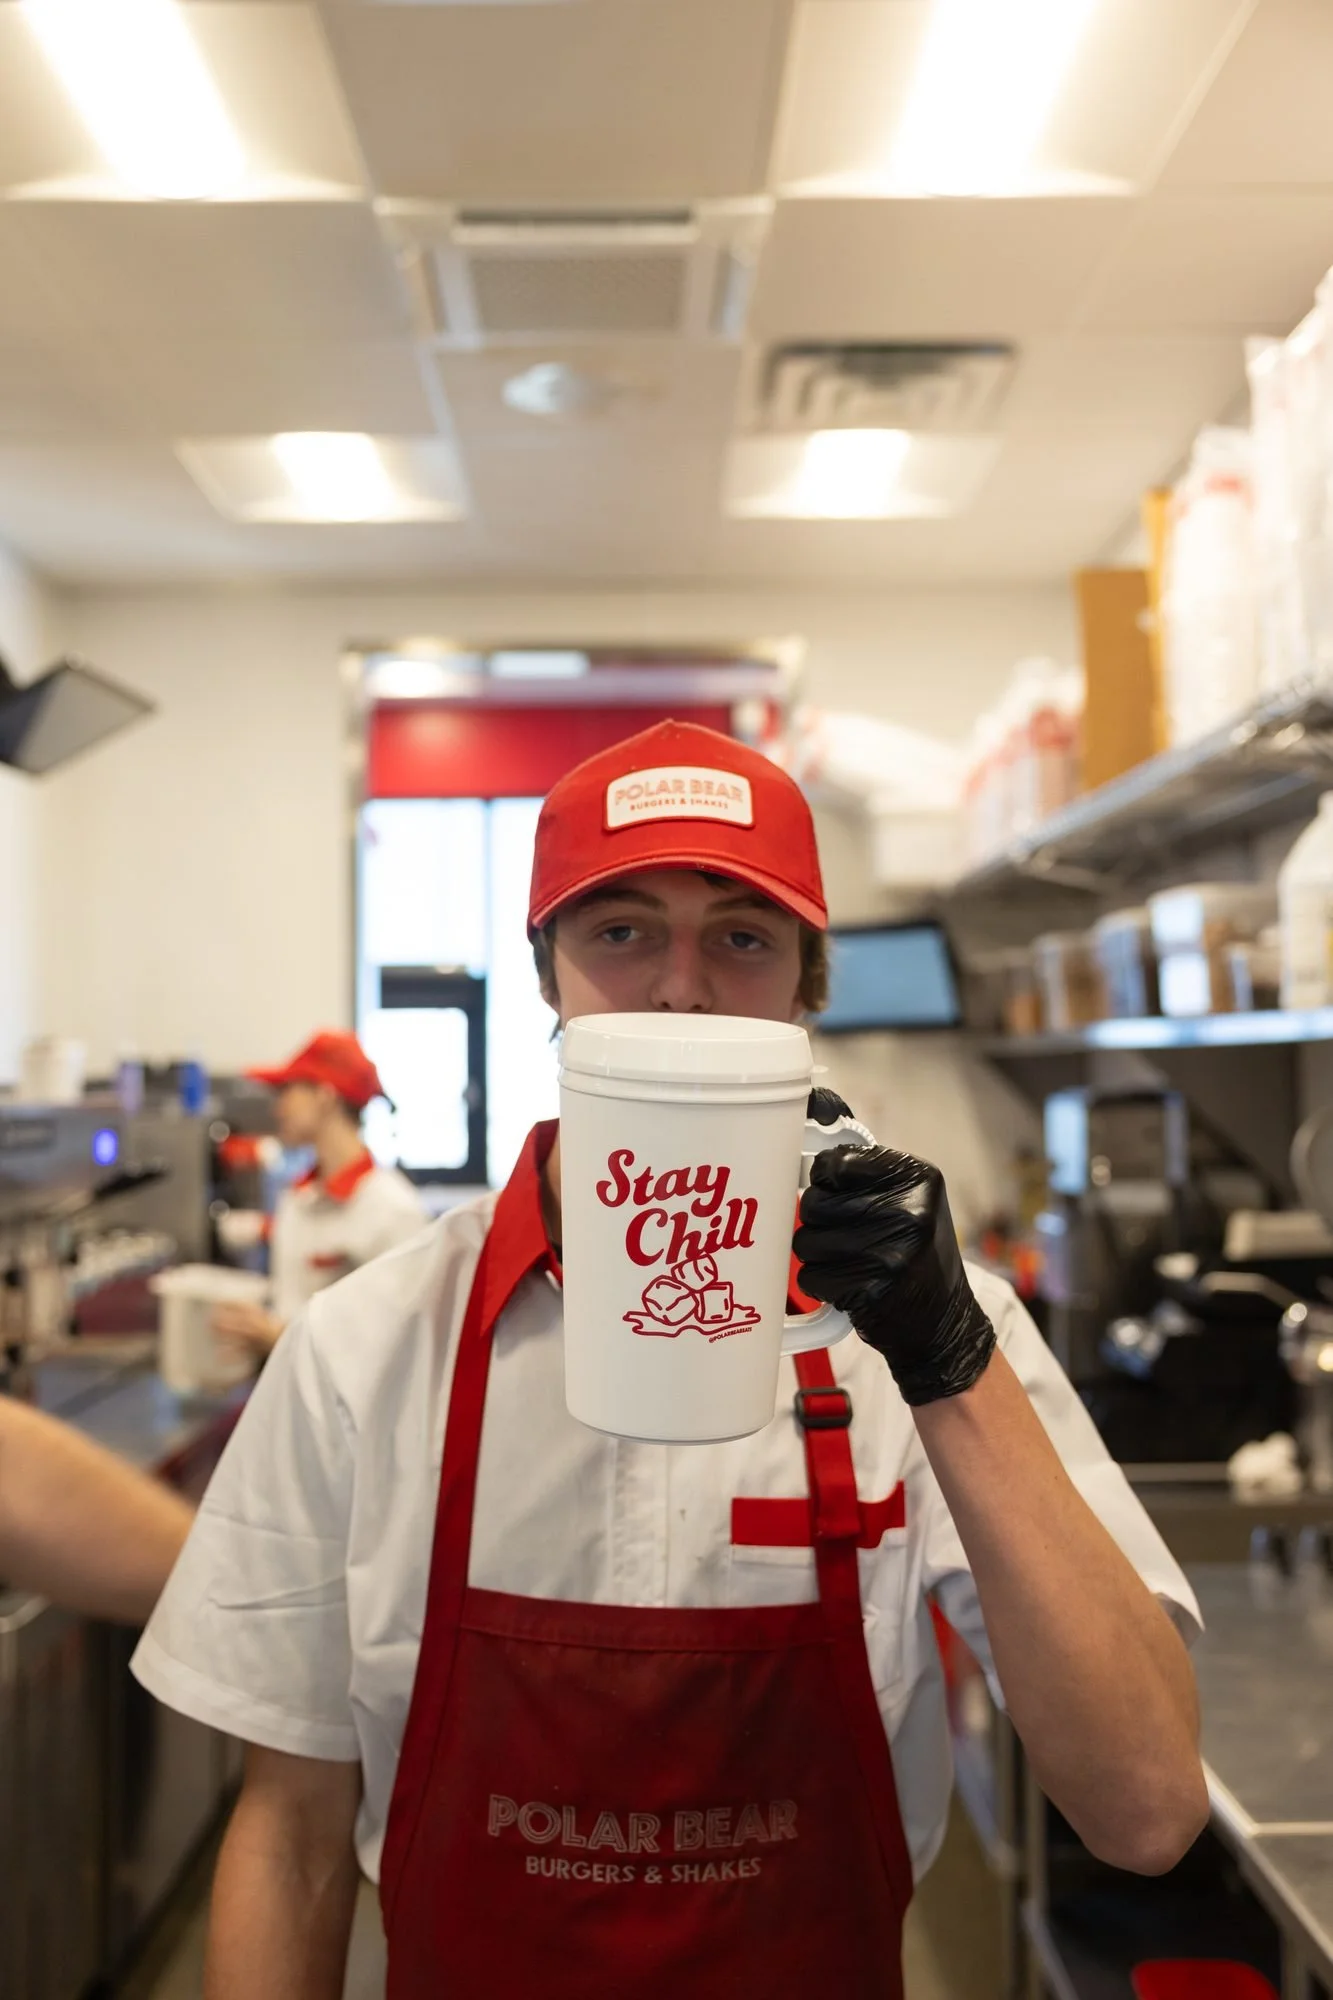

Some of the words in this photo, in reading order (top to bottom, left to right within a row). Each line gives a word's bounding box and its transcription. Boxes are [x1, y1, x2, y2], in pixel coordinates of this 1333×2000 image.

[615, 779, 685, 805] POLAR
[690, 779, 744, 803] BEAR
[596, 1149, 730, 1217] Stay
[625, 1198, 758, 1267] Chill
[487, 1794, 661, 1854] POLAR
[673, 1799, 799, 1852] BEAR
[525, 1855, 636, 1883] BURGERS
[643, 1865, 663, 1884] &
[671, 1857, 763, 1883] SHAKES
